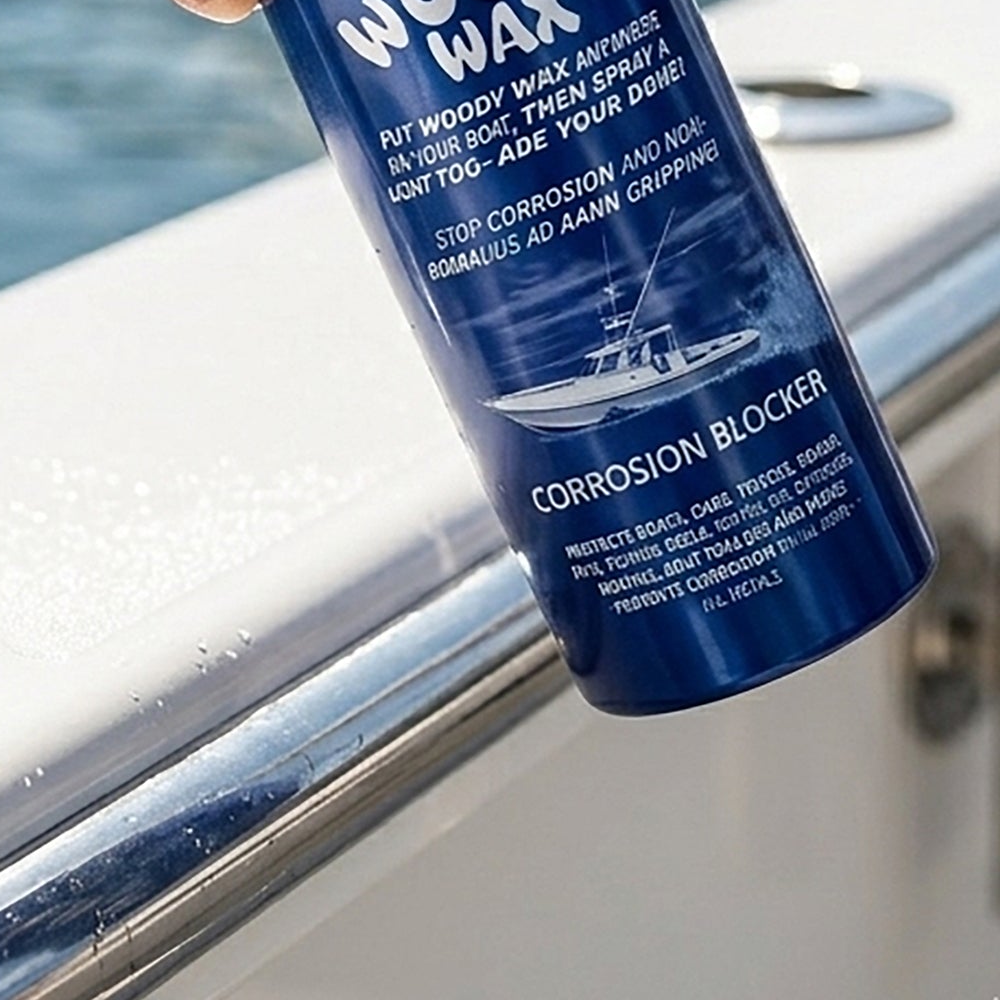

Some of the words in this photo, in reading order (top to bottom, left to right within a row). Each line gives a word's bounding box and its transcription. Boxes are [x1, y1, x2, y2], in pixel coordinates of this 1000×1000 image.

[418, 85, 505, 137] WOODY
[511, 57, 570, 100] WAX
[592, 43, 653, 94] SPRAY
[658, 37, 671, 60] A
[498, 128, 549, 167] ADE
[555, 94, 623, 140] YOUR
[435, 217, 482, 250] STOP
[487, 161, 615, 232] CORROSION
[526, 221, 555, 249] AD
[560, 190, 620, 236] AANN
[531, 432, 707, 514] CORROSION
[709, 368, 829, 451] BLOCKER
